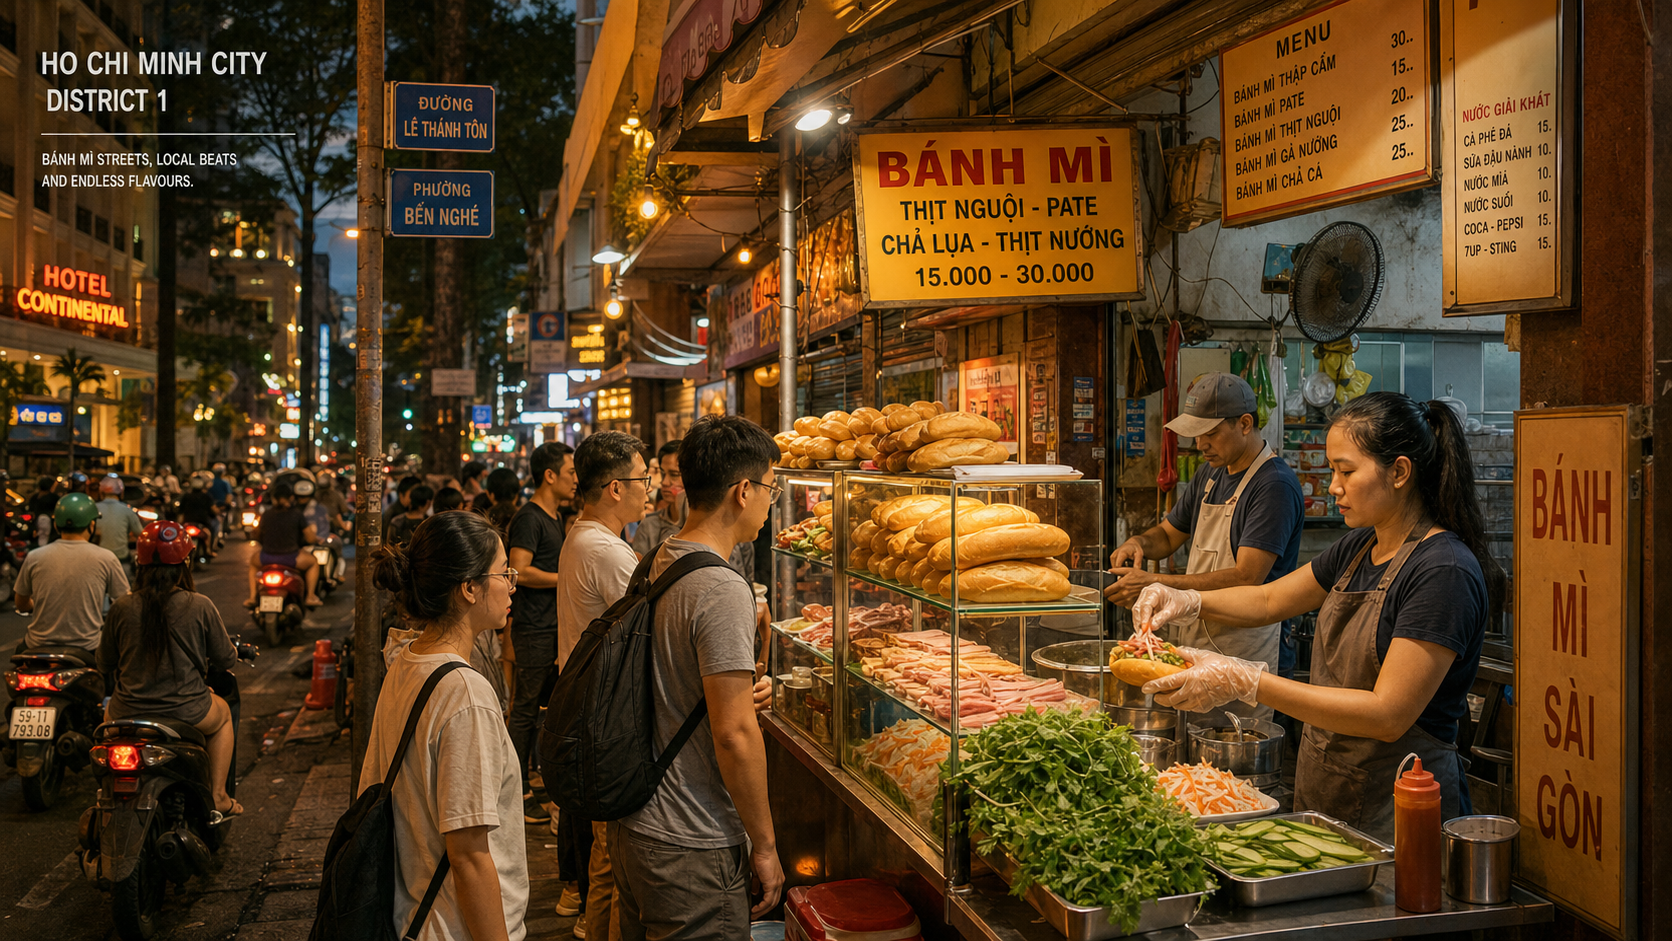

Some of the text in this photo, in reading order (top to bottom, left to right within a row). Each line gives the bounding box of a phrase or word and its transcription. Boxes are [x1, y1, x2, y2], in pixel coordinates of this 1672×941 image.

[1276, 20, 1332, 59] MENU
[1234, 83, 1260, 104] BÁNH
[1264, 74, 1275, 93] MÌ
[1279, 64, 1307, 86] THẬP
[1520, 90, 1551, 112] KHÁT
[418, 94, 473, 112] ĐƯỜNG
[1234, 107, 1261, 128] BÁNH
[1264, 98, 1276, 118] MÌ
[1279, 91, 1305, 114] PATE
[404, 116, 488, 139] LÊ THÁNH TÔN
[1235, 132, 1261, 152] BÁNH
[1265, 124, 1276, 143] MÌ
[1279, 118, 1303, 138] THỊT
[1306, 104, 1341, 130] NGUỘI
[877, 136, 1113, 188] BÁNH MÌ
[1235, 156, 1262, 176] BÁNH
[1265, 148, 1277, 168] MÌ
[1280, 142, 1295, 164] GÀ
[413, 180, 471, 197] PHƯỜNG
[1236, 181, 1262, 200] BÁNH
[1266, 173, 1277, 193] MÌ
[1307, 162, 1323, 182] CÁ
[405, 201, 480, 226] BẾN NGHÉ
[900, 200, 947, 225] THỊT
[955, 193, 1025, 223] NGUỘI
[1047, 196, 1098, 218] PATE
[1464, 221, 1489, 235] COCA
[1497, 216, 1524, 231] PEPSI
[881, 228, 926, 255] CHẢ
[932, 233, 974, 258] LỤA
[996, 231, 1043, 256] THỊT
[1049, 225, 1125, 251] NƯỚNG
[1464, 244, 1481, 257] 7UP
[1489, 240, 1517, 255] STING
[44, 264, 111, 298] HOTEL
[915, 265, 992, 287] 15.000
[1016, 262, 1095, 284] 30.000
[17, 287, 129, 328] CONTINENTAL
[1532, 453, 1612, 546] BÁNH
[1552, 569, 1588, 658] MÌ
[13, 724, 51, 737] 793.08
[1544, 677, 1595, 761] SÀI
[1536, 770, 1602, 862] GÒN
